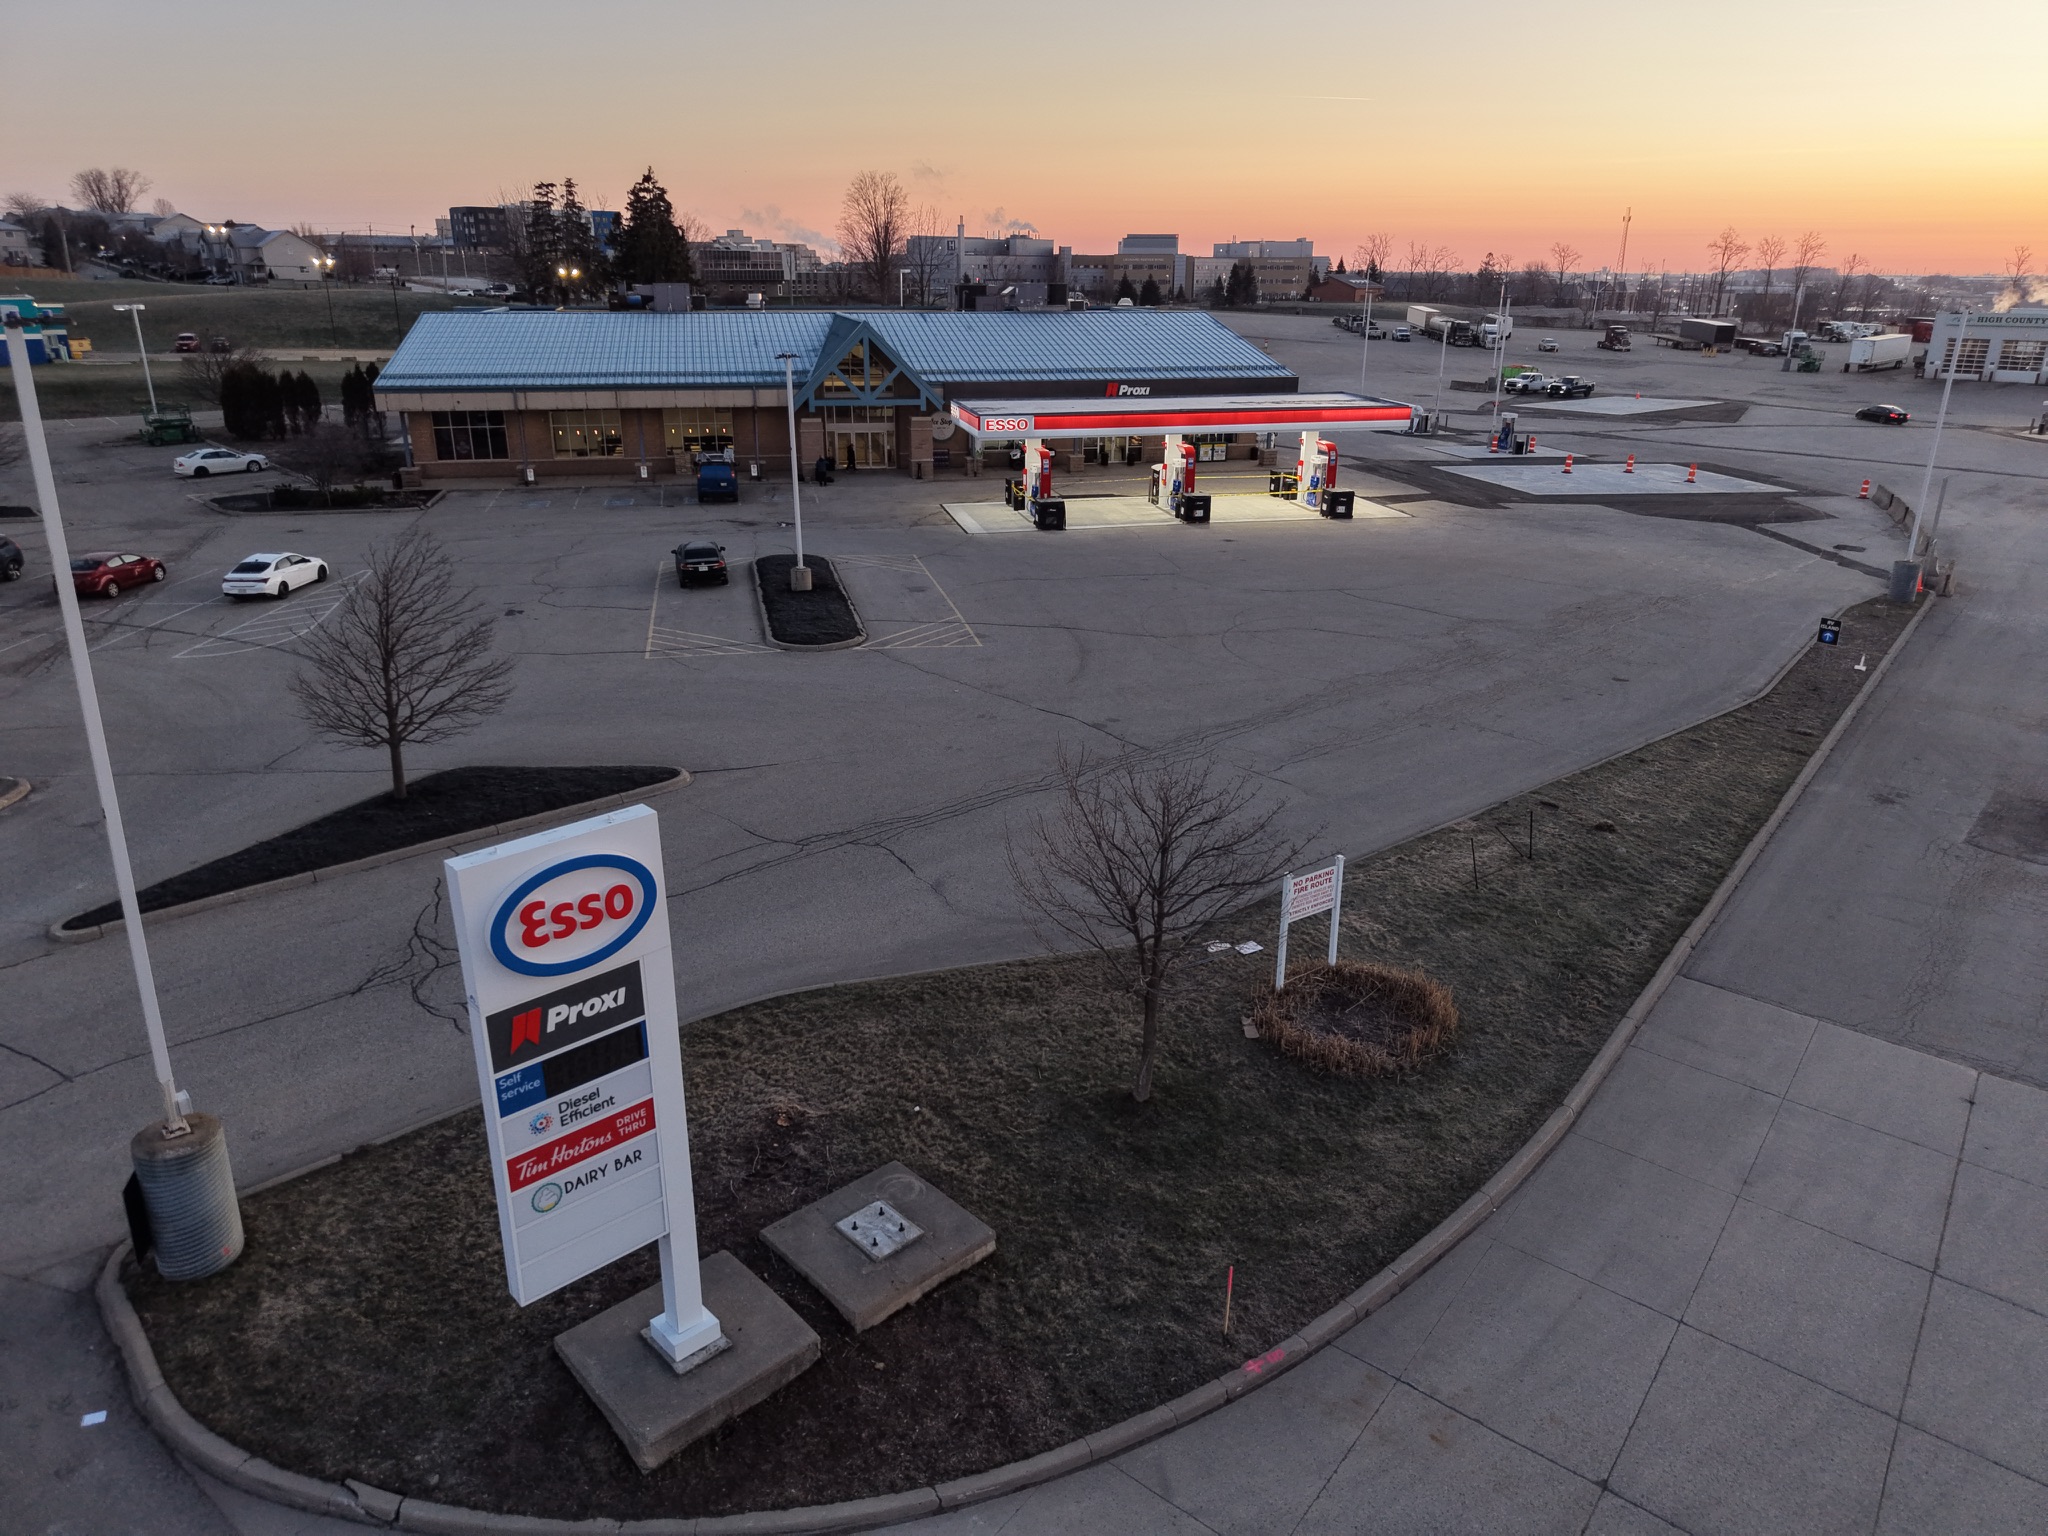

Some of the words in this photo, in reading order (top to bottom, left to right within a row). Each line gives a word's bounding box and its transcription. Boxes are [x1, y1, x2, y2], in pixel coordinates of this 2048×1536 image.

[1977, 316, 2003, 324] HIGH
[2005, 316, 2048, 325] COUNTY
[940, 417, 953, 426] Stop
[985, 418, 1029, 432] ESSO
[1820, 623, 1840, 632] ISLAND
[1293, 880, 1303, 888] NO
[1305, 869, 1334, 883] PARKING
[1293, 884, 1309, 895] FIRE
[1310, 877, 1332, 889] ROUTE
[519, 884, 634, 948] Esso
[498, 1071, 523, 1090] Self
[501, 1078, 542, 1102] service
[558, 1087, 601, 1115] Diesel
[560, 1095, 616, 1127] Efficient
[616, 1108, 647, 1128] DRIVE
[617, 1117, 648, 1137] THRU
[516, 1156, 549, 1182] Tim
[550, 1131, 613, 1168] Hortons
[564, 1163, 609, 1195] DAIRY
[614, 1149, 643, 1172] BAR
